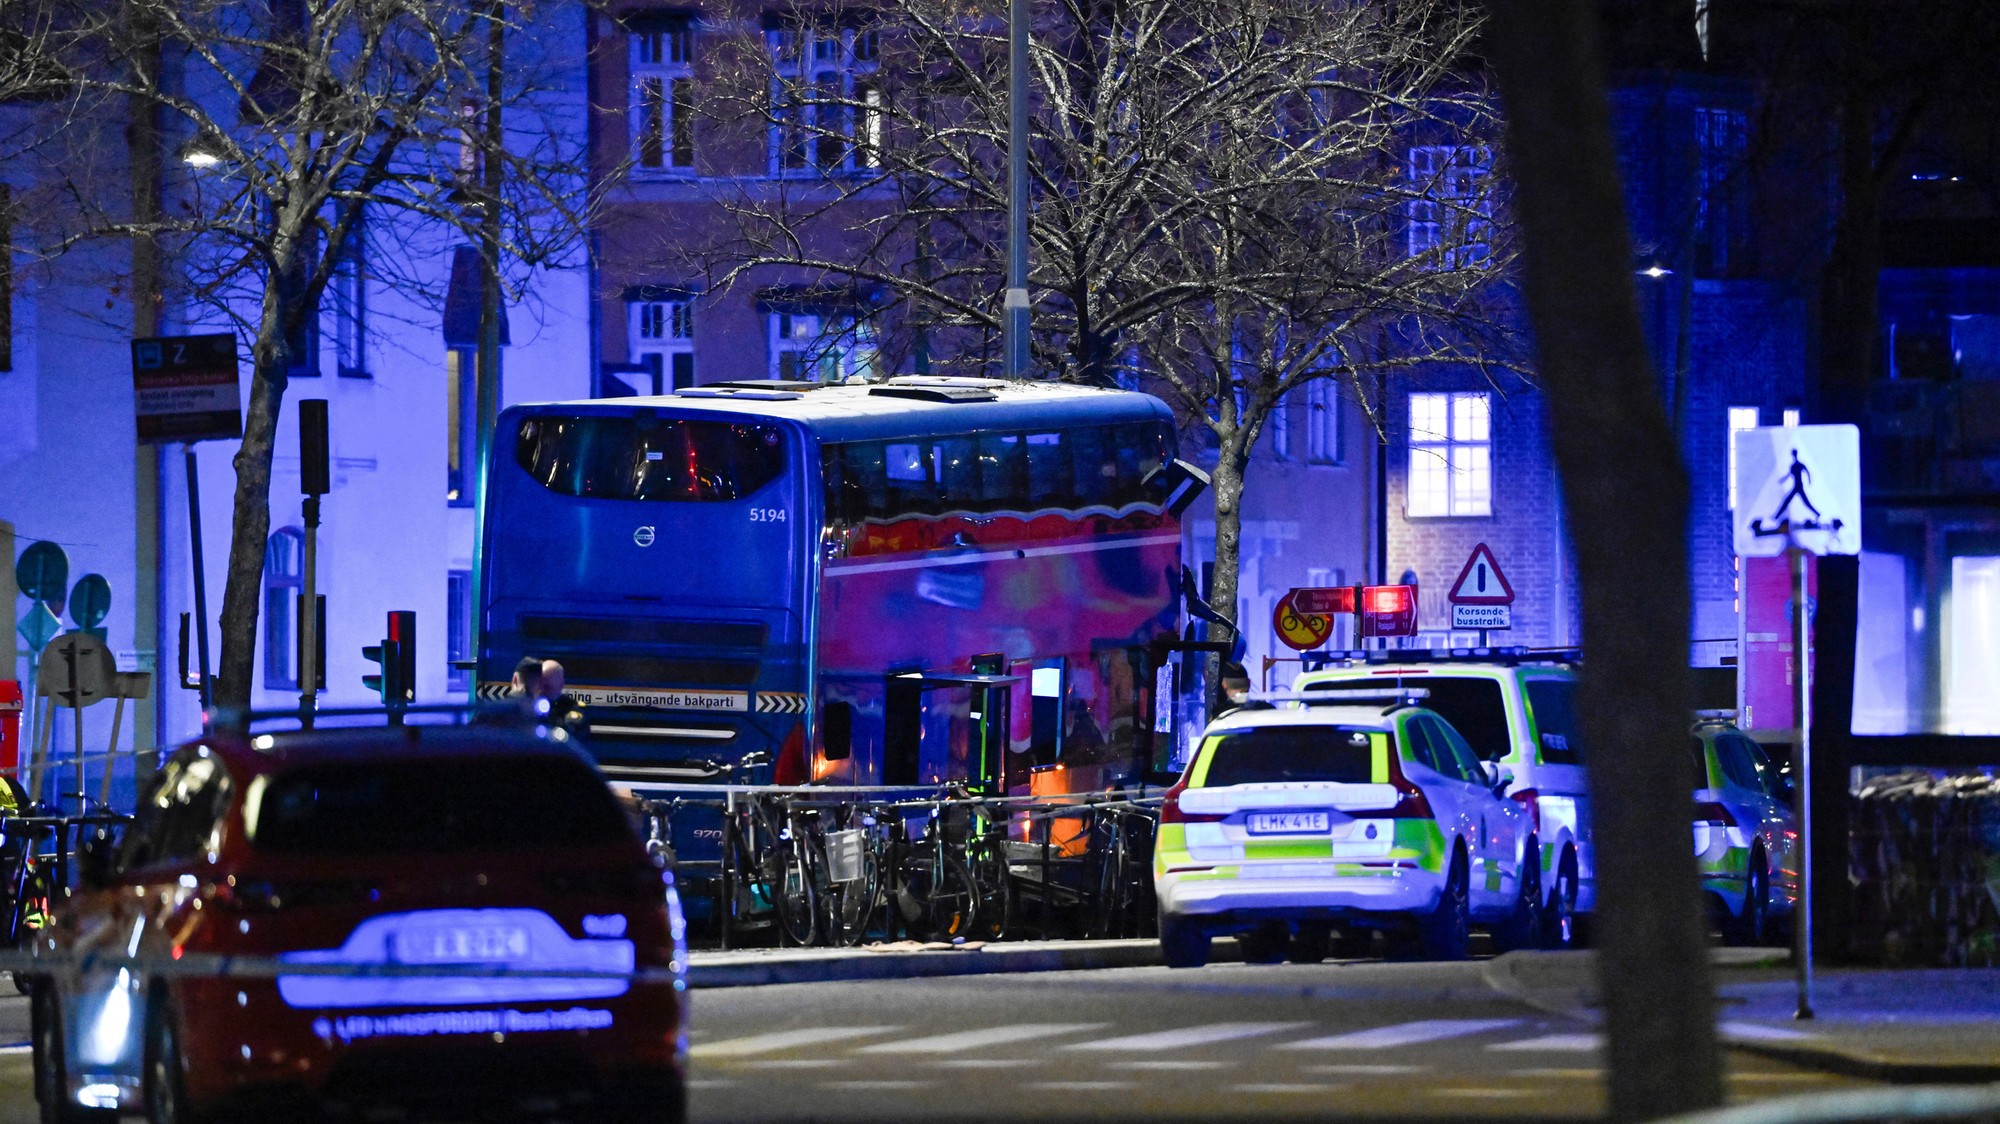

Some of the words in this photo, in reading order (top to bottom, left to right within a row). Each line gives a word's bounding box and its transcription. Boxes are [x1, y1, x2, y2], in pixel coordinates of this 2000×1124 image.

[173, 344, 187, 364] Z
[750, 508, 786, 522] 5194
[1458, 607, 1504, 616] Korsande
[1456, 617, 1506, 626] busstrafik
[606, 692, 680, 707] utsvängande
[685, 694, 734, 709] bakparti
[1259, 814, 1287, 831] LMK
[1293, 814, 1321, 829] 41E
[693, 829, 723, 839] 970
